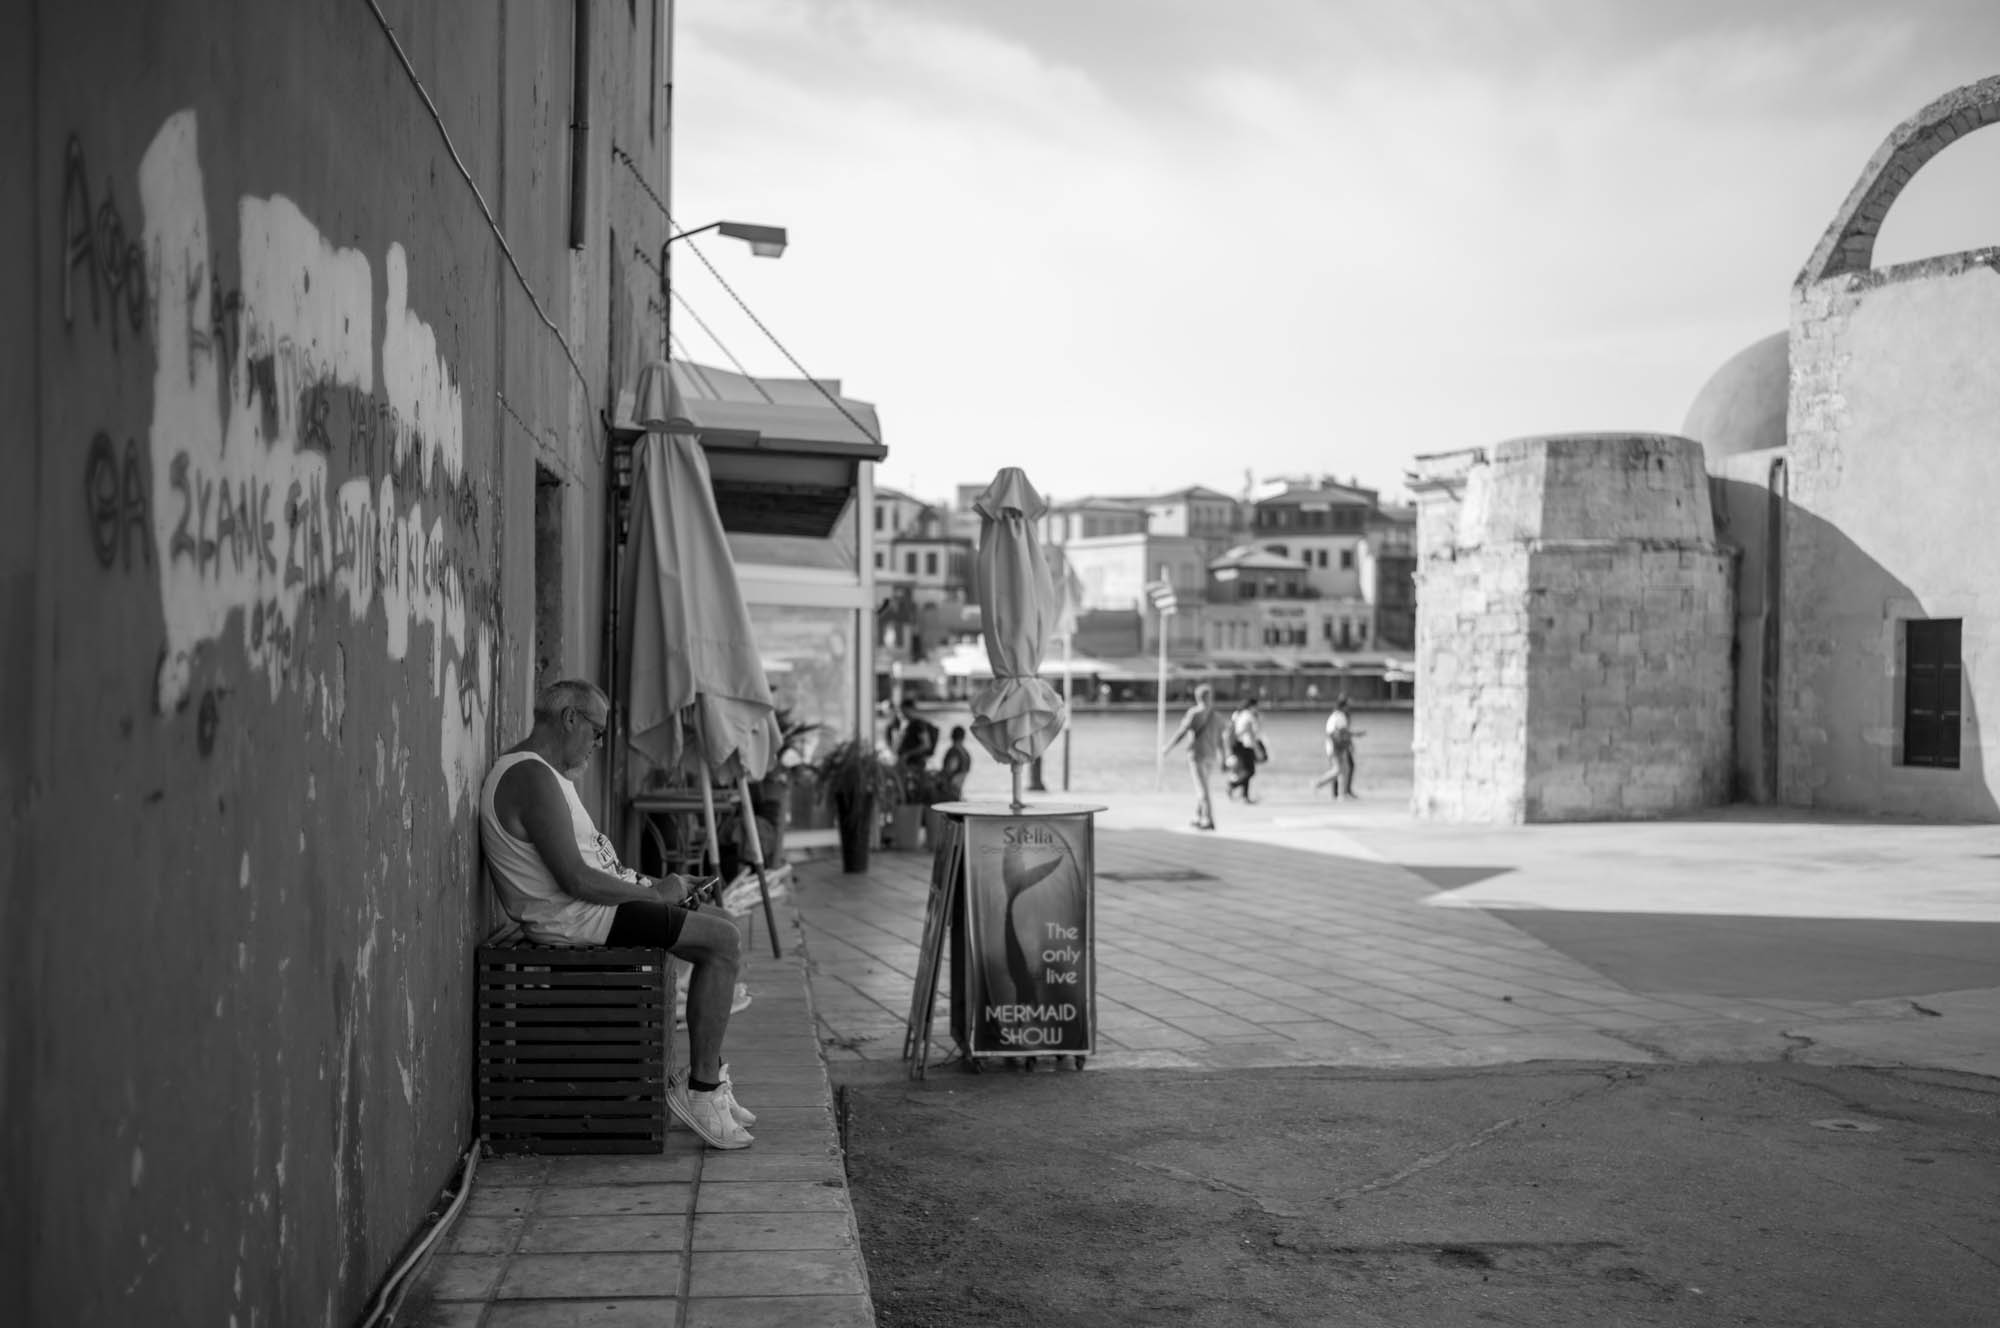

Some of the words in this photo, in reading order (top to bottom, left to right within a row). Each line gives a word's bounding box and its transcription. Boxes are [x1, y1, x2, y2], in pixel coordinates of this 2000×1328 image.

[85, 431, 150, 576] ΘΑ
[1003, 826, 1053, 845] Stella
[1045, 922, 1079, 940] The
[1042, 945, 1081, 964] only
[1046, 967, 1078, 985] live
[985, 1003, 1077, 1023] MERMAID
[1000, 1027, 1063, 1046] SHOW
